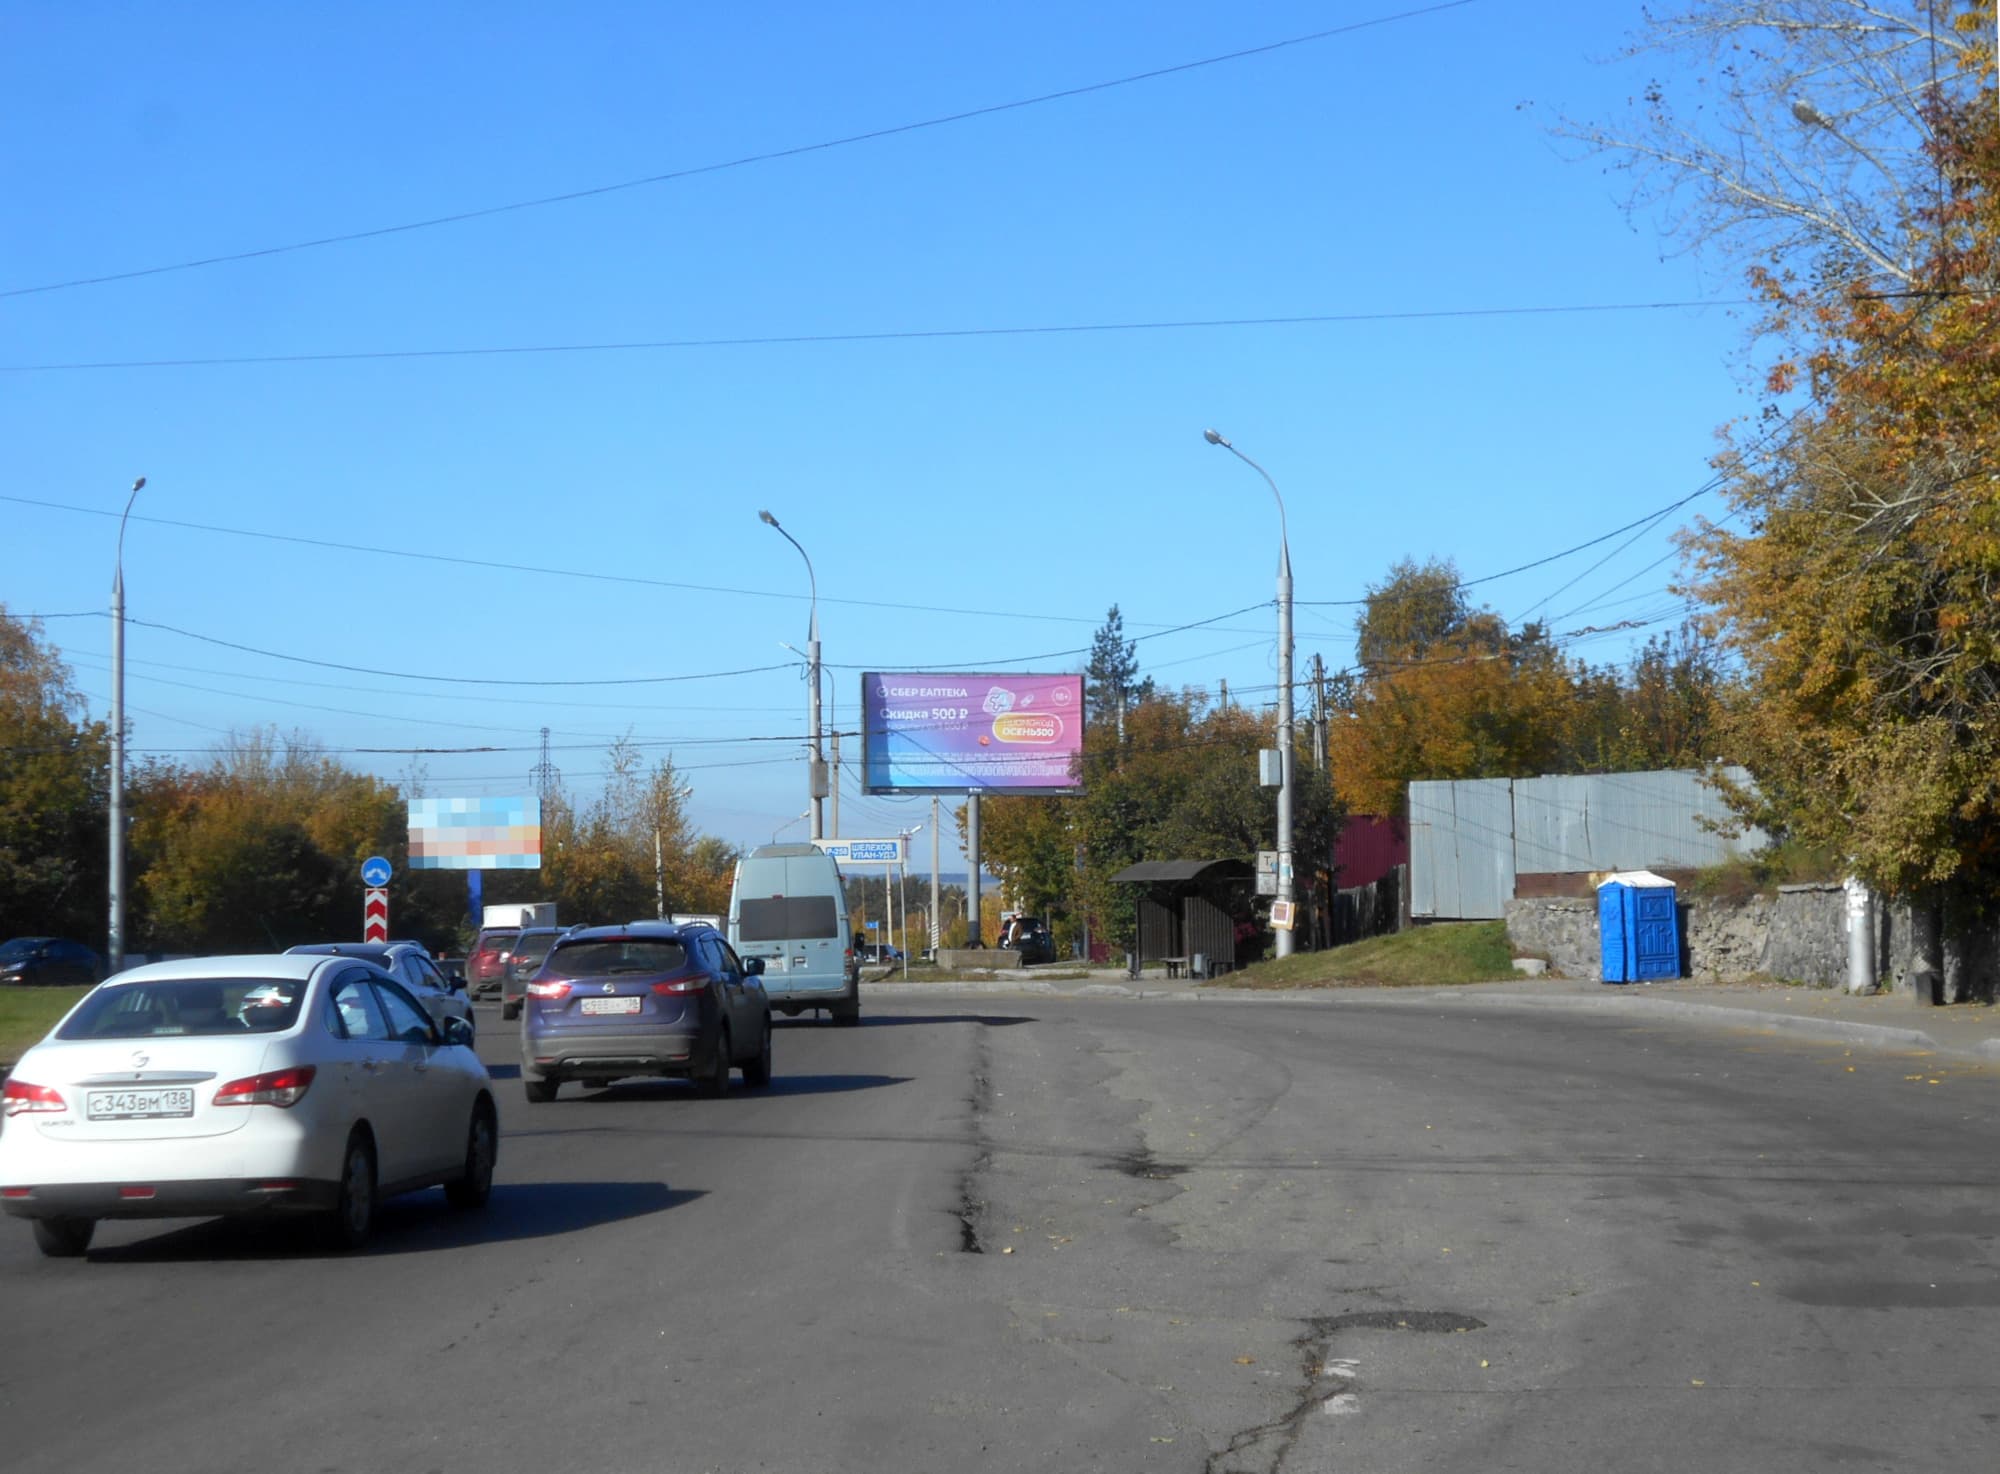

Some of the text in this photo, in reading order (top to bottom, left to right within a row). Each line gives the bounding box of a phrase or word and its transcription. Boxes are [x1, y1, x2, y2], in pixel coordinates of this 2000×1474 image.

[890, 687, 968, 697] СБЕР ЕАПТЕКА
[880, 708, 928, 720] Скидка
[932, 708, 956, 720] 500
[1002, 727, 1054, 737] ОСЕНЬ500
[163, 1092, 188, 1105] 138
